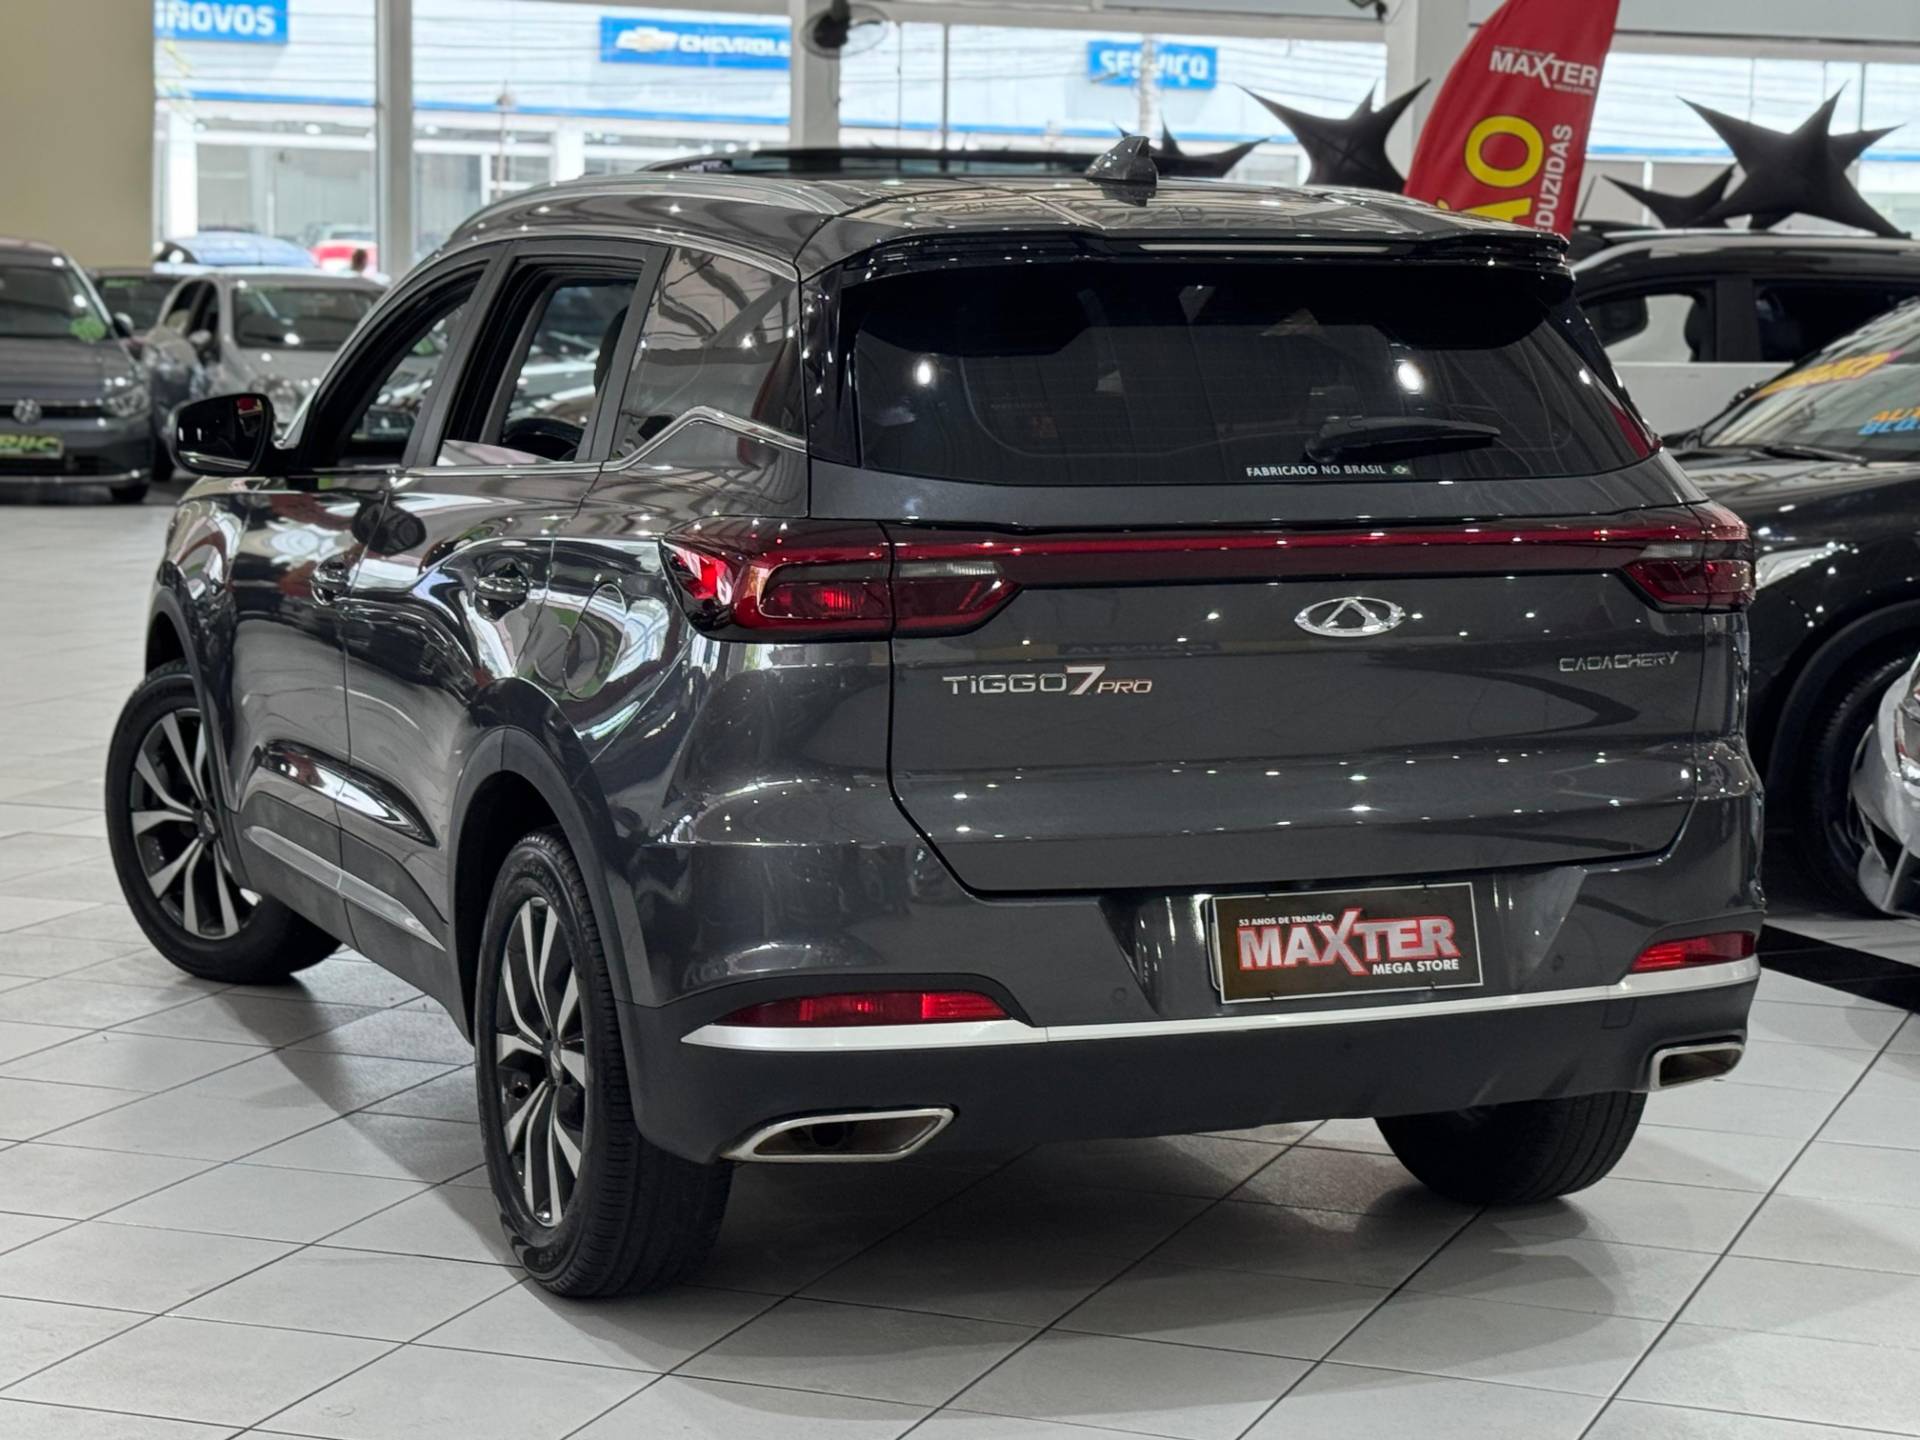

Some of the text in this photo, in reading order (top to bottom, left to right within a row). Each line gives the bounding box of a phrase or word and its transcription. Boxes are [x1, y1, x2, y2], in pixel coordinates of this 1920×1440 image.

[1489, 50, 1598, 88] MAXTER
[1246, 464, 1387, 477] FABRICADO NO BRASIL
[1064, 665, 1106, 695] 7
[1096, 679, 1153, 694] PRO
[1239, 912, 1335, 926] 53 ANOS DE TRADIÇÃO
[1237, 907, 1461, 975] MAXTER
[1372, 959, 1460, 975] MEGA STORE
